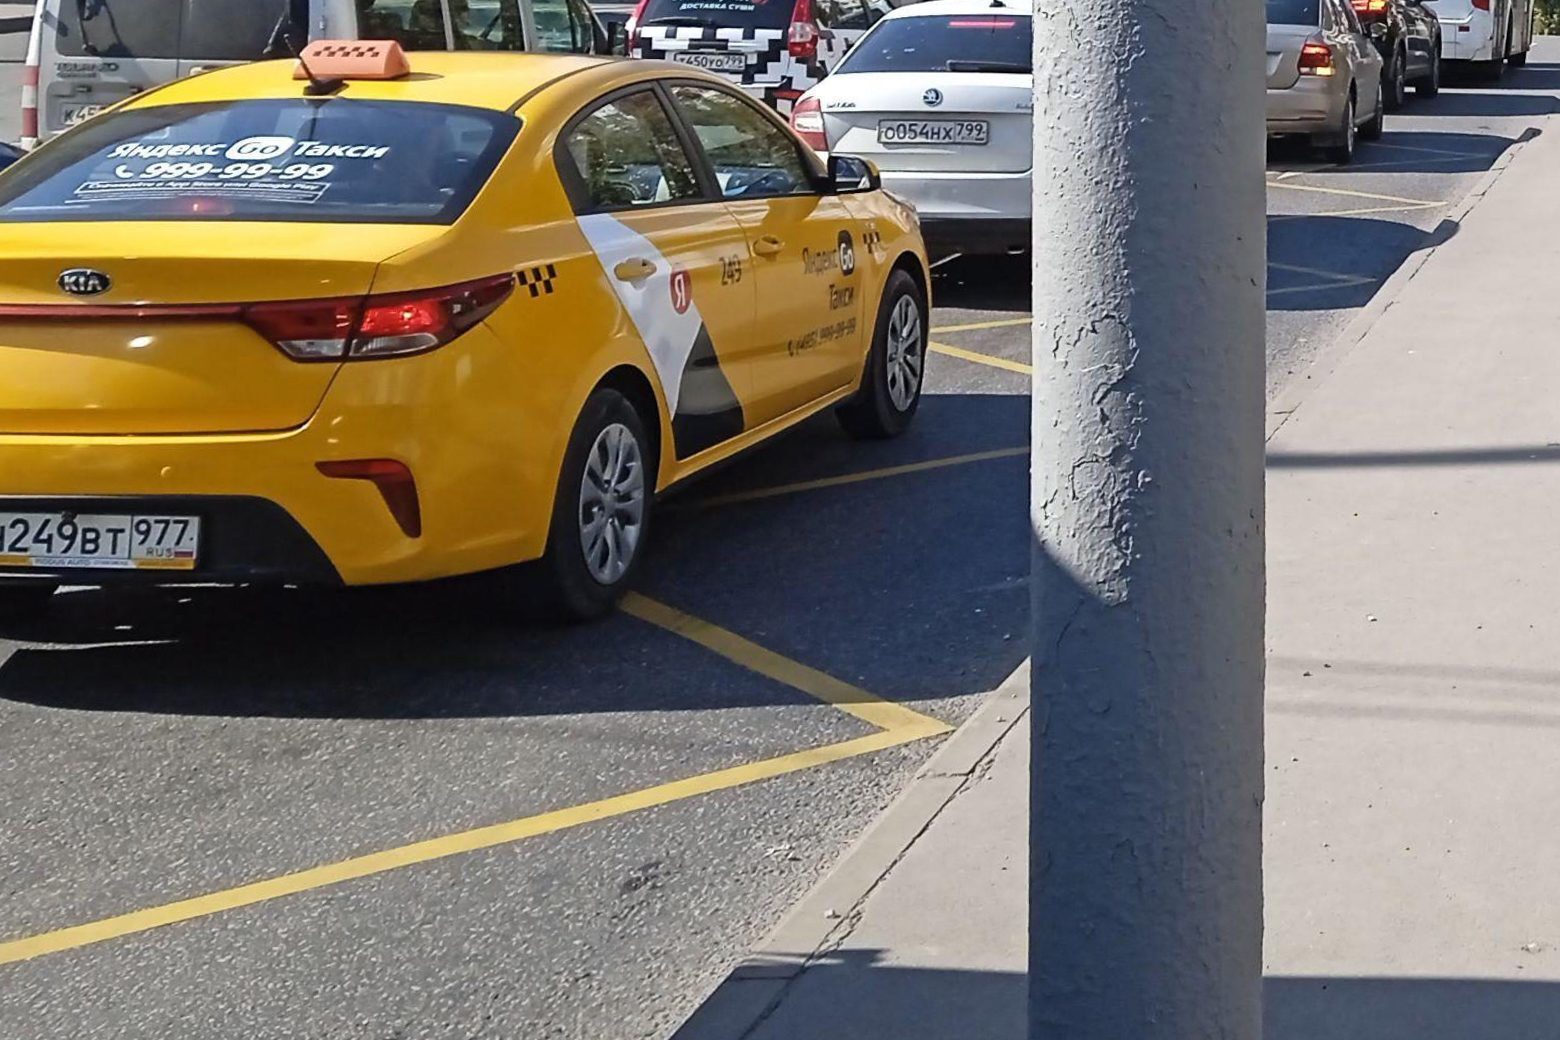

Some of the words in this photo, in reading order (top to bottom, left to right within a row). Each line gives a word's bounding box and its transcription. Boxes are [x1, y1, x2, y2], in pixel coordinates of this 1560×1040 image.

[957, 123, 983, 136] 799
[107, 141, 227, 159] Яндекс
[294, 141, 390, 159] Такси
[140, 162, 334, 180] 999-99-99
[840, 242, 854, 271] Go
[719, 254, 742, 286] 249
[63, 275, 102, 291] KIA
[674, 273, 686, 309] Я
[134, 518, 189, 547] 977
[146, 548, 173, 559] RUS
